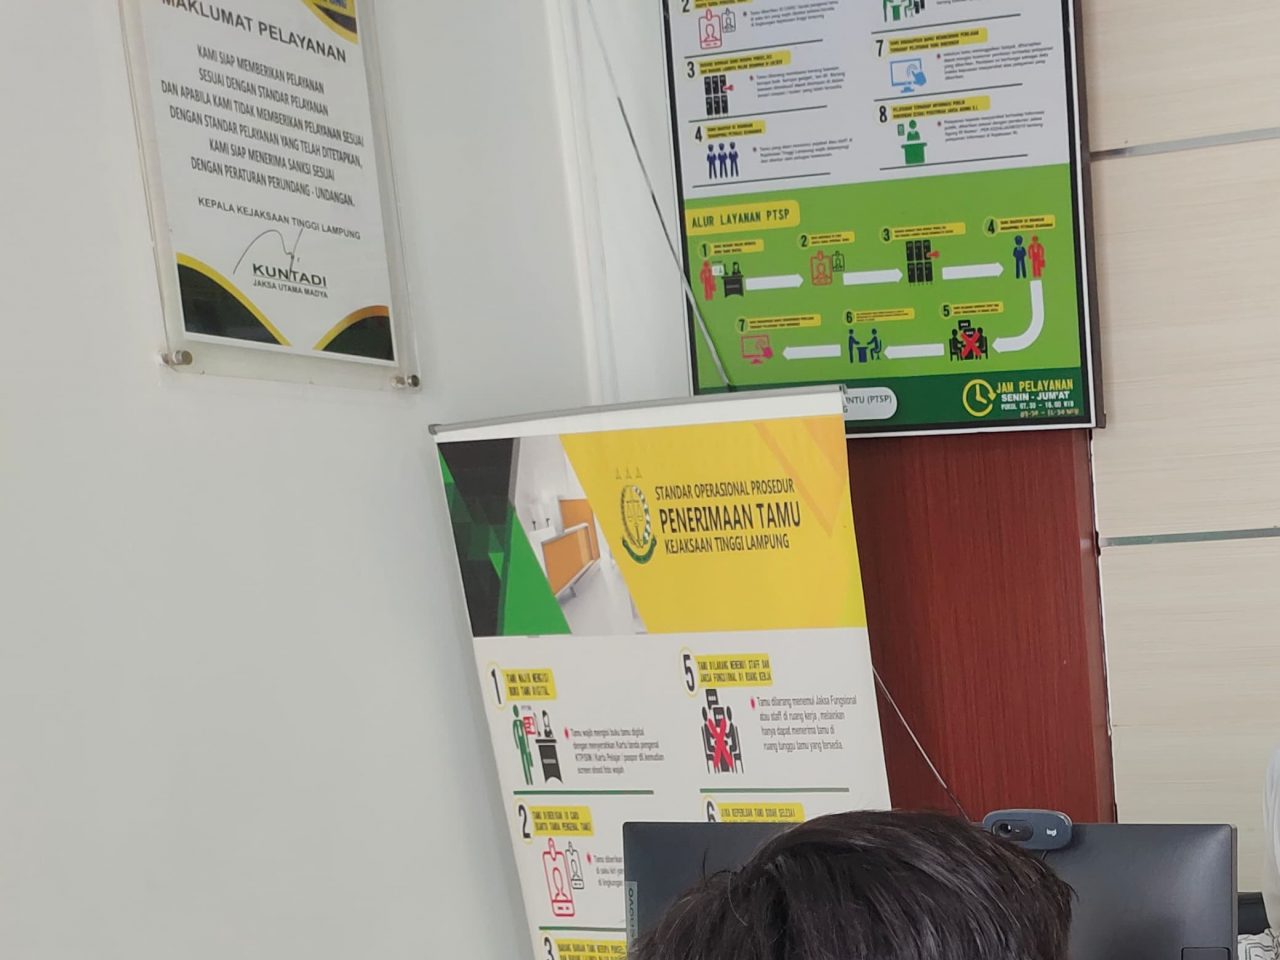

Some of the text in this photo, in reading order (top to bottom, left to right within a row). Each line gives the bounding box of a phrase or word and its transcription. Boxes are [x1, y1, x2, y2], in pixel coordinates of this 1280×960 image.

[682, 0, 690, 13] 2
[258, 21, 347, 63] PELAYANAN
[875, 40, 884, 57] 7
[197, 44, 325, 94] KAMI SIAP MEMBERIKAN PELAYANAN
[687, 61, 695, 78] 3
[199, 67, 329, 117] SESUAI DENGAN STANDAR PELAYANAN
[161, 79, 364, 147] DAN APABILA KAMI TIDAK MEMBERIKAN PELAYANAN SESUAI
[879, 105, 888, 123] 8
[169, 105, 203, 126] DENGAN
[204, 114, 238, 135] STANDAR
[239, 124, 279, 146] PELAYANAN
[280, 135, 299, 151] YANG
[300, 140, 320, 156] TELAH
[695, 126, 703, 142] 4
[209, 138, 335, 181] KAMI SIAP MENERIMA SANKSI SESUAI
[191, 156, 223, 176] DENGAN
[224, 164, 267, 187] PERATURAN
[267, 175, 310, 197] PERUNDANG
[198, 197, 361, 240] KEPALA KEJAKSAAN TINGGI LAMPUNG
[692, 208, 790, 229] ALUR LAYANAN PTSP
[987, 219, 995, 234] 4
[800, 235, 807, 247] 2
[883, 228, 890, 242] 3
[702, 243, 708, 257] 1
[252, 263, 327, 287] KUNTADI
[253, 279, 328, 298] JAKSA UTAMA MADYA
[846, 311, 853, 324] 6
[943, 305, 950, 317] 5
[738, 319, 746, 331] 7
[996, 379, 1073, 393] JAM PELAYANAN
[845, 395, 892, 405] INTU (PTSP)
[1001, 392, 1029, 402] SENIN
[1036, 391, 1070, 401] JUM'AT
[655, 478, 795, 500] STANDAR OPERASIONAL PROSEDUR
[659, 501, 801, 534] PENERIMAAN TAMU
[665, 533, 790, 554] KEJAKSAAN TINGGI LAMPUNG
[683, 654, 695, 692] 5
[491, 668, 502, 705] 1
[518, 804, 531, 838] 2
